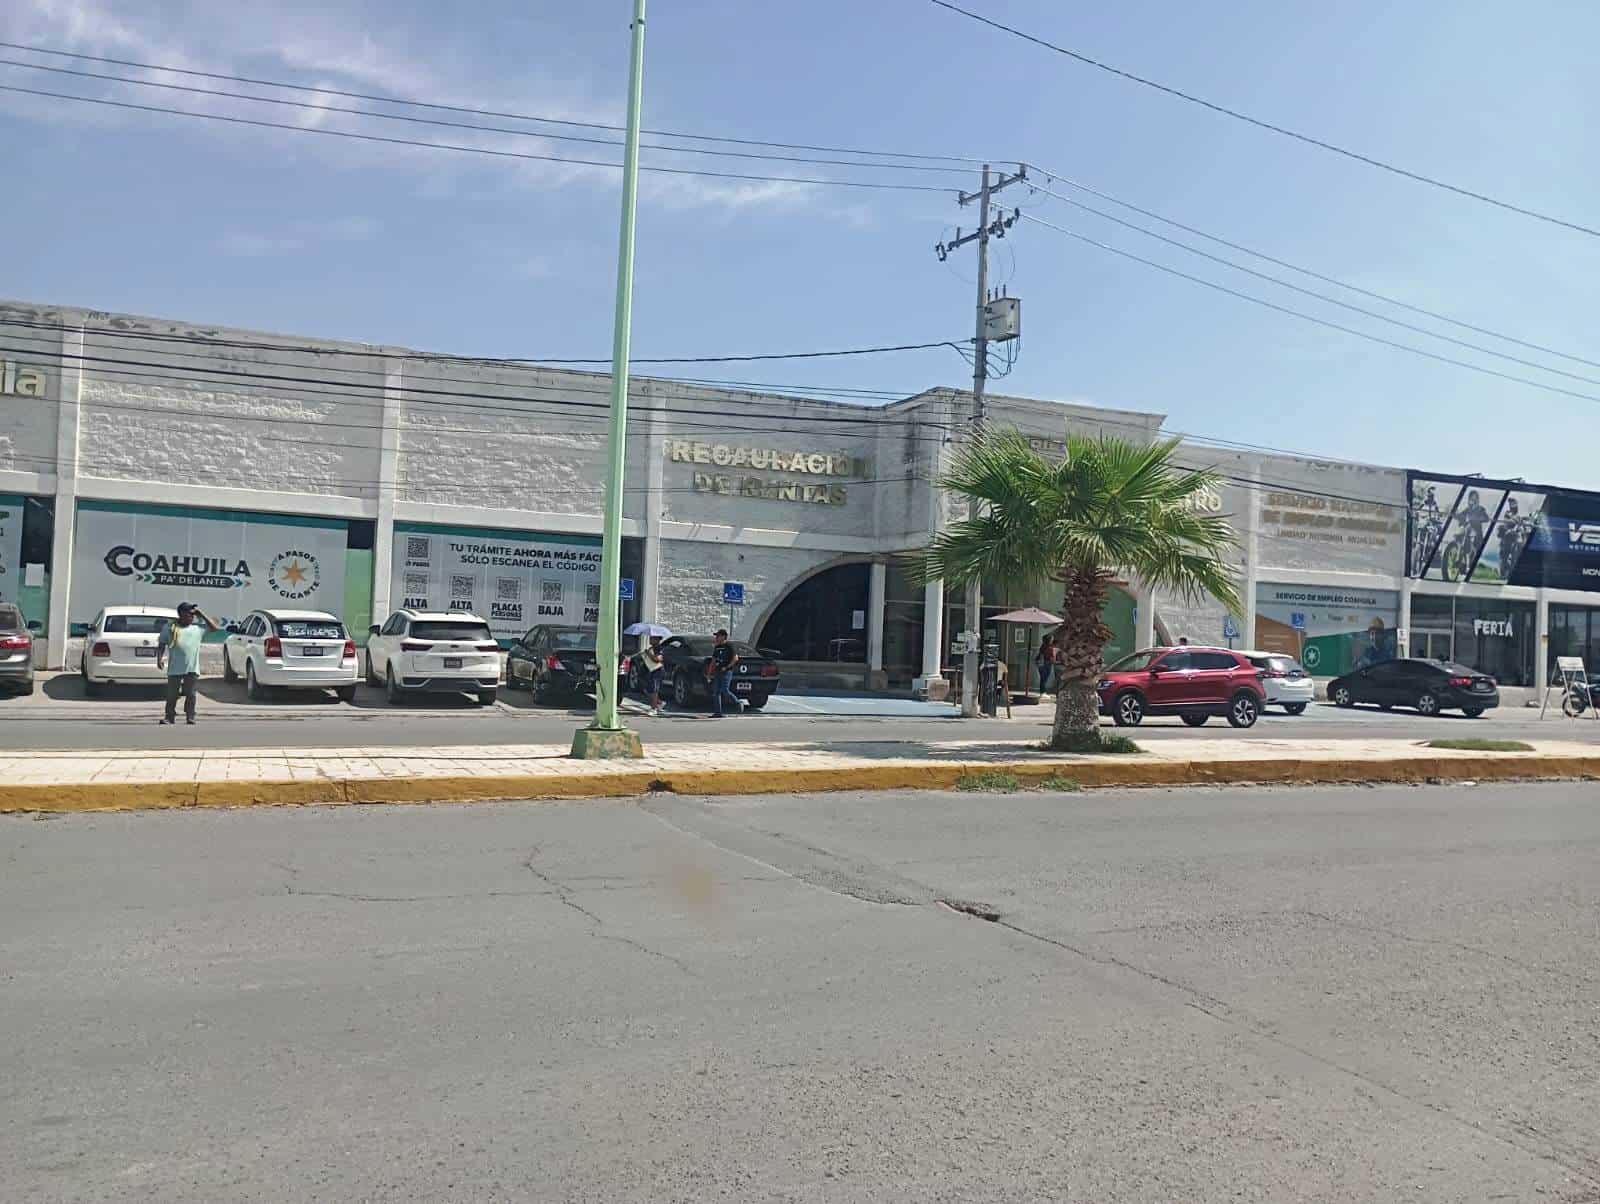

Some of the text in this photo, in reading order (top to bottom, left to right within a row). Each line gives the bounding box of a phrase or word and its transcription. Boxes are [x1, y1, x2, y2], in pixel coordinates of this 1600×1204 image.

[466, 544, 511, 556] TRÁMITE
[513, 548, 551, 558] AHORA
[553, 550, 576, 560] MÁS
[579, 552, 602, 562] FÁCI
[104, 545, 252, 577] COAHUILA
[492, 557, 540, 568] ESCANEA
[556, 560, 596, 572] CÓDIGO
[178, 577, 226, 586] DELANTE
[403, 598, 427, 608] ALTA
[450, 600, 473, 611] ALTA
[491, 603, 522, 612] PLACAS
[538, 606, 564, 616] BAJA
